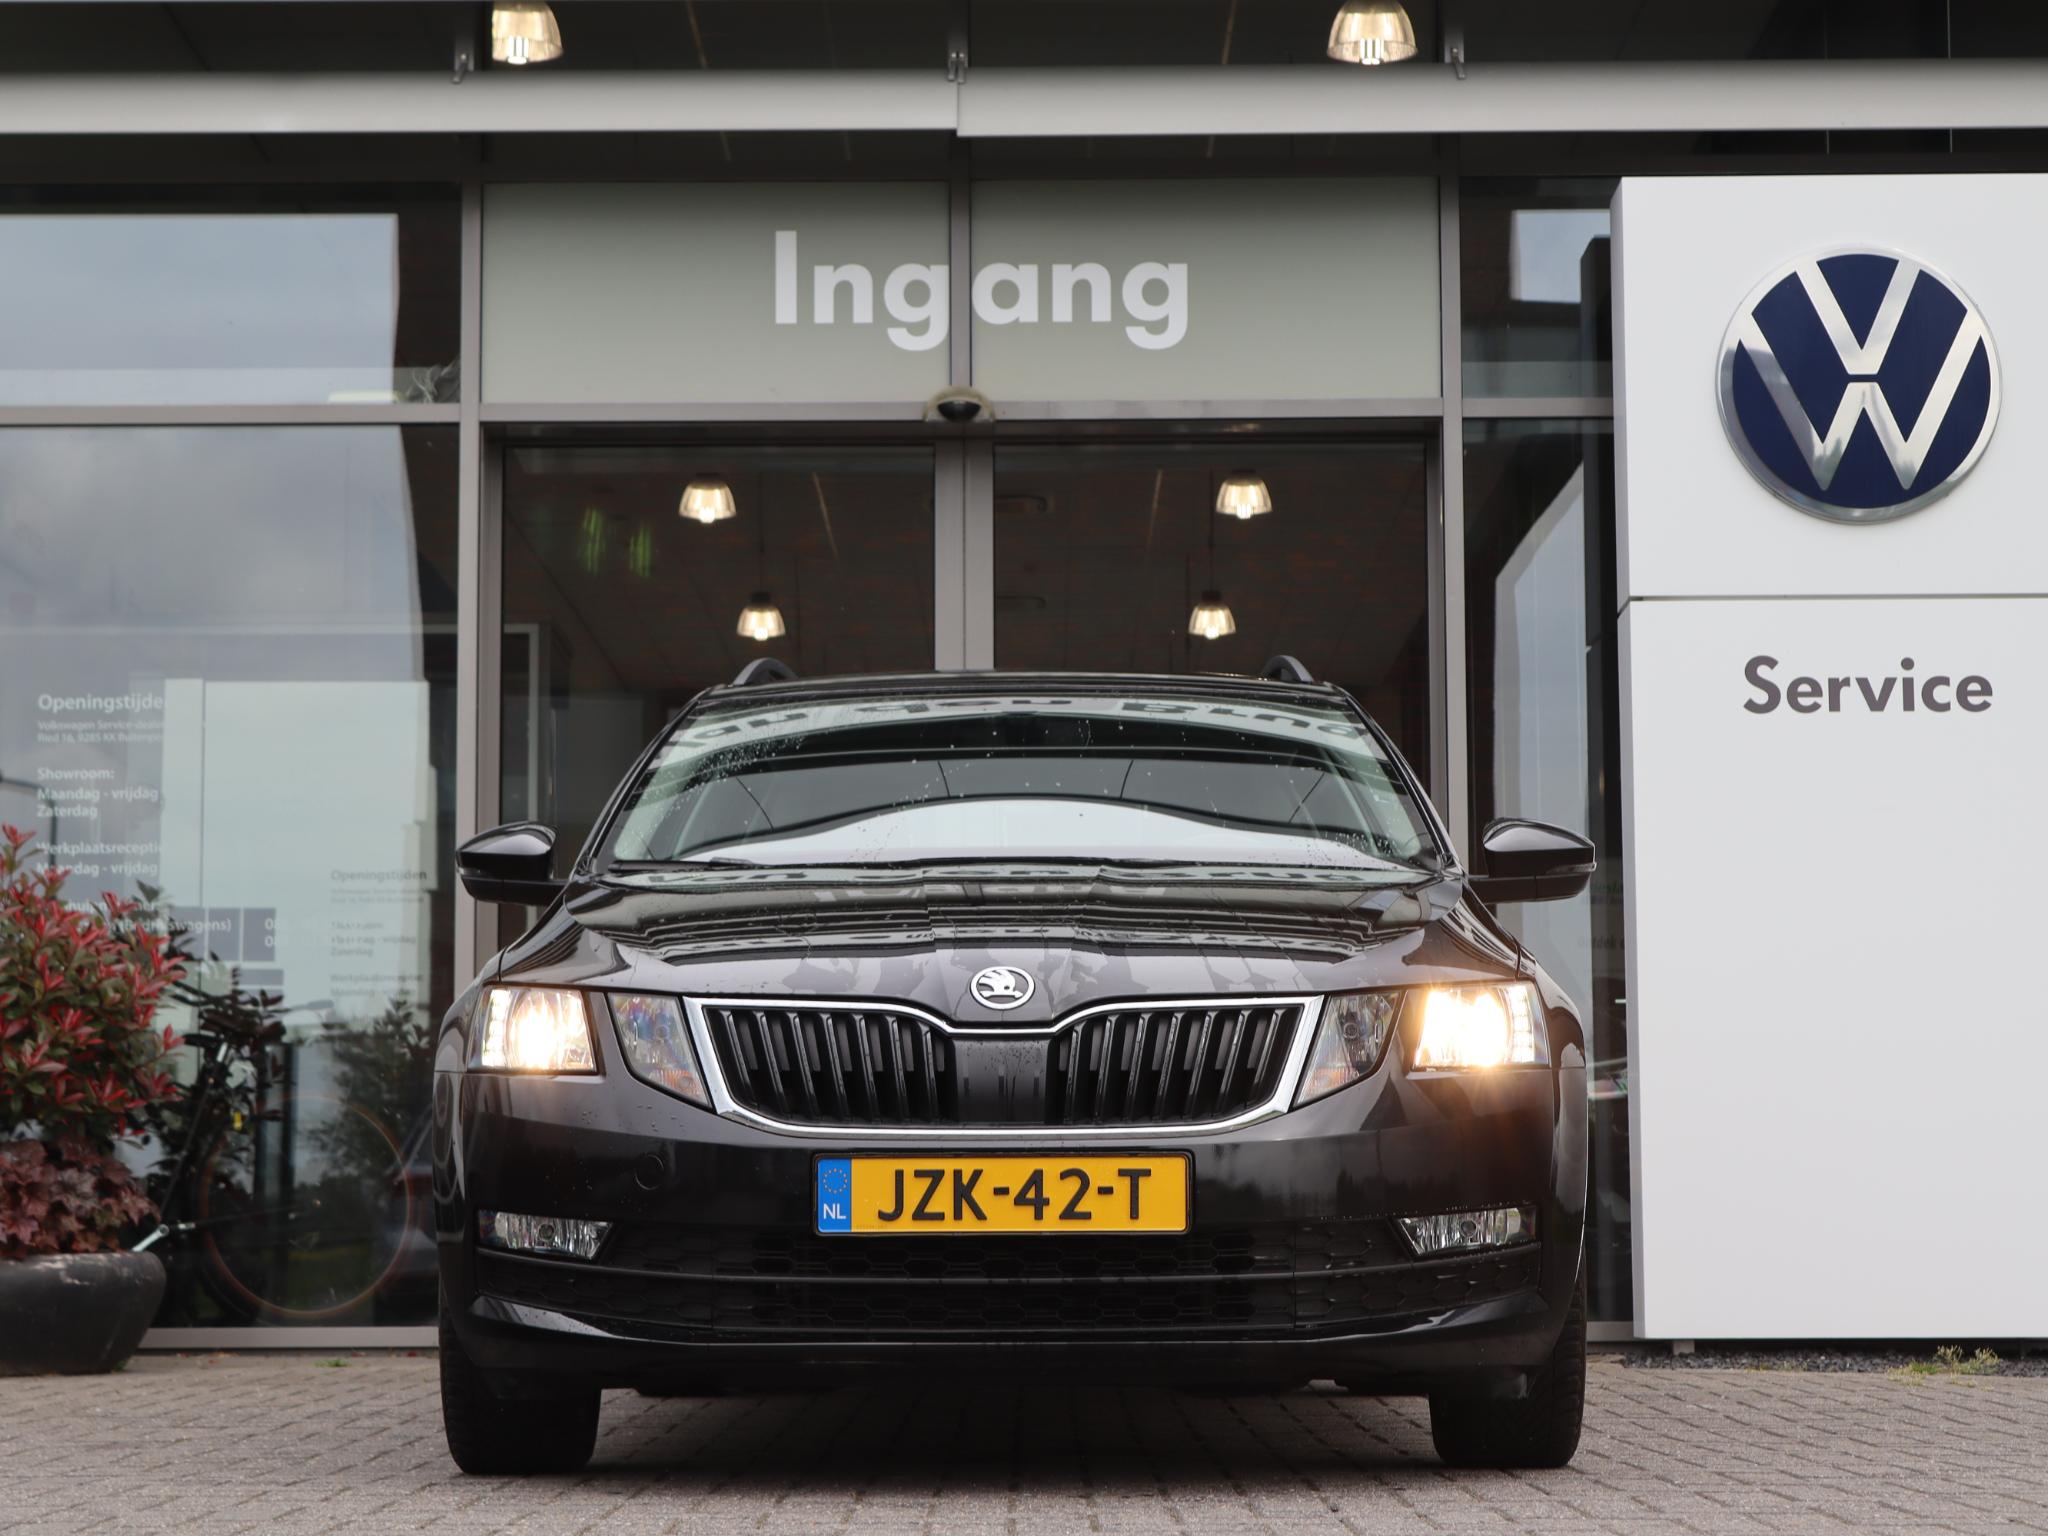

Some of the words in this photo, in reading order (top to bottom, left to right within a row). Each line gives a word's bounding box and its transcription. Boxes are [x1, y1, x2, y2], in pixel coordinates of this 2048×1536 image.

[775, 230, 1188, 351] Ingang
[1743, 655, 1993, 714] Service
[37, 693, 166, 714] Openingstijde
[37, 768, 115, 780] Showroom:
[37, 787, 101, 803] Maandag
[111, 786, 159, 802] vrijdag
[37, 804, 98, 820] Zaterdag
[111, 861, 159, 876] vrijdag
[878, 1168, 1152, 1222] JZK-42-T
[823, 1203, 847, 1219] NL
